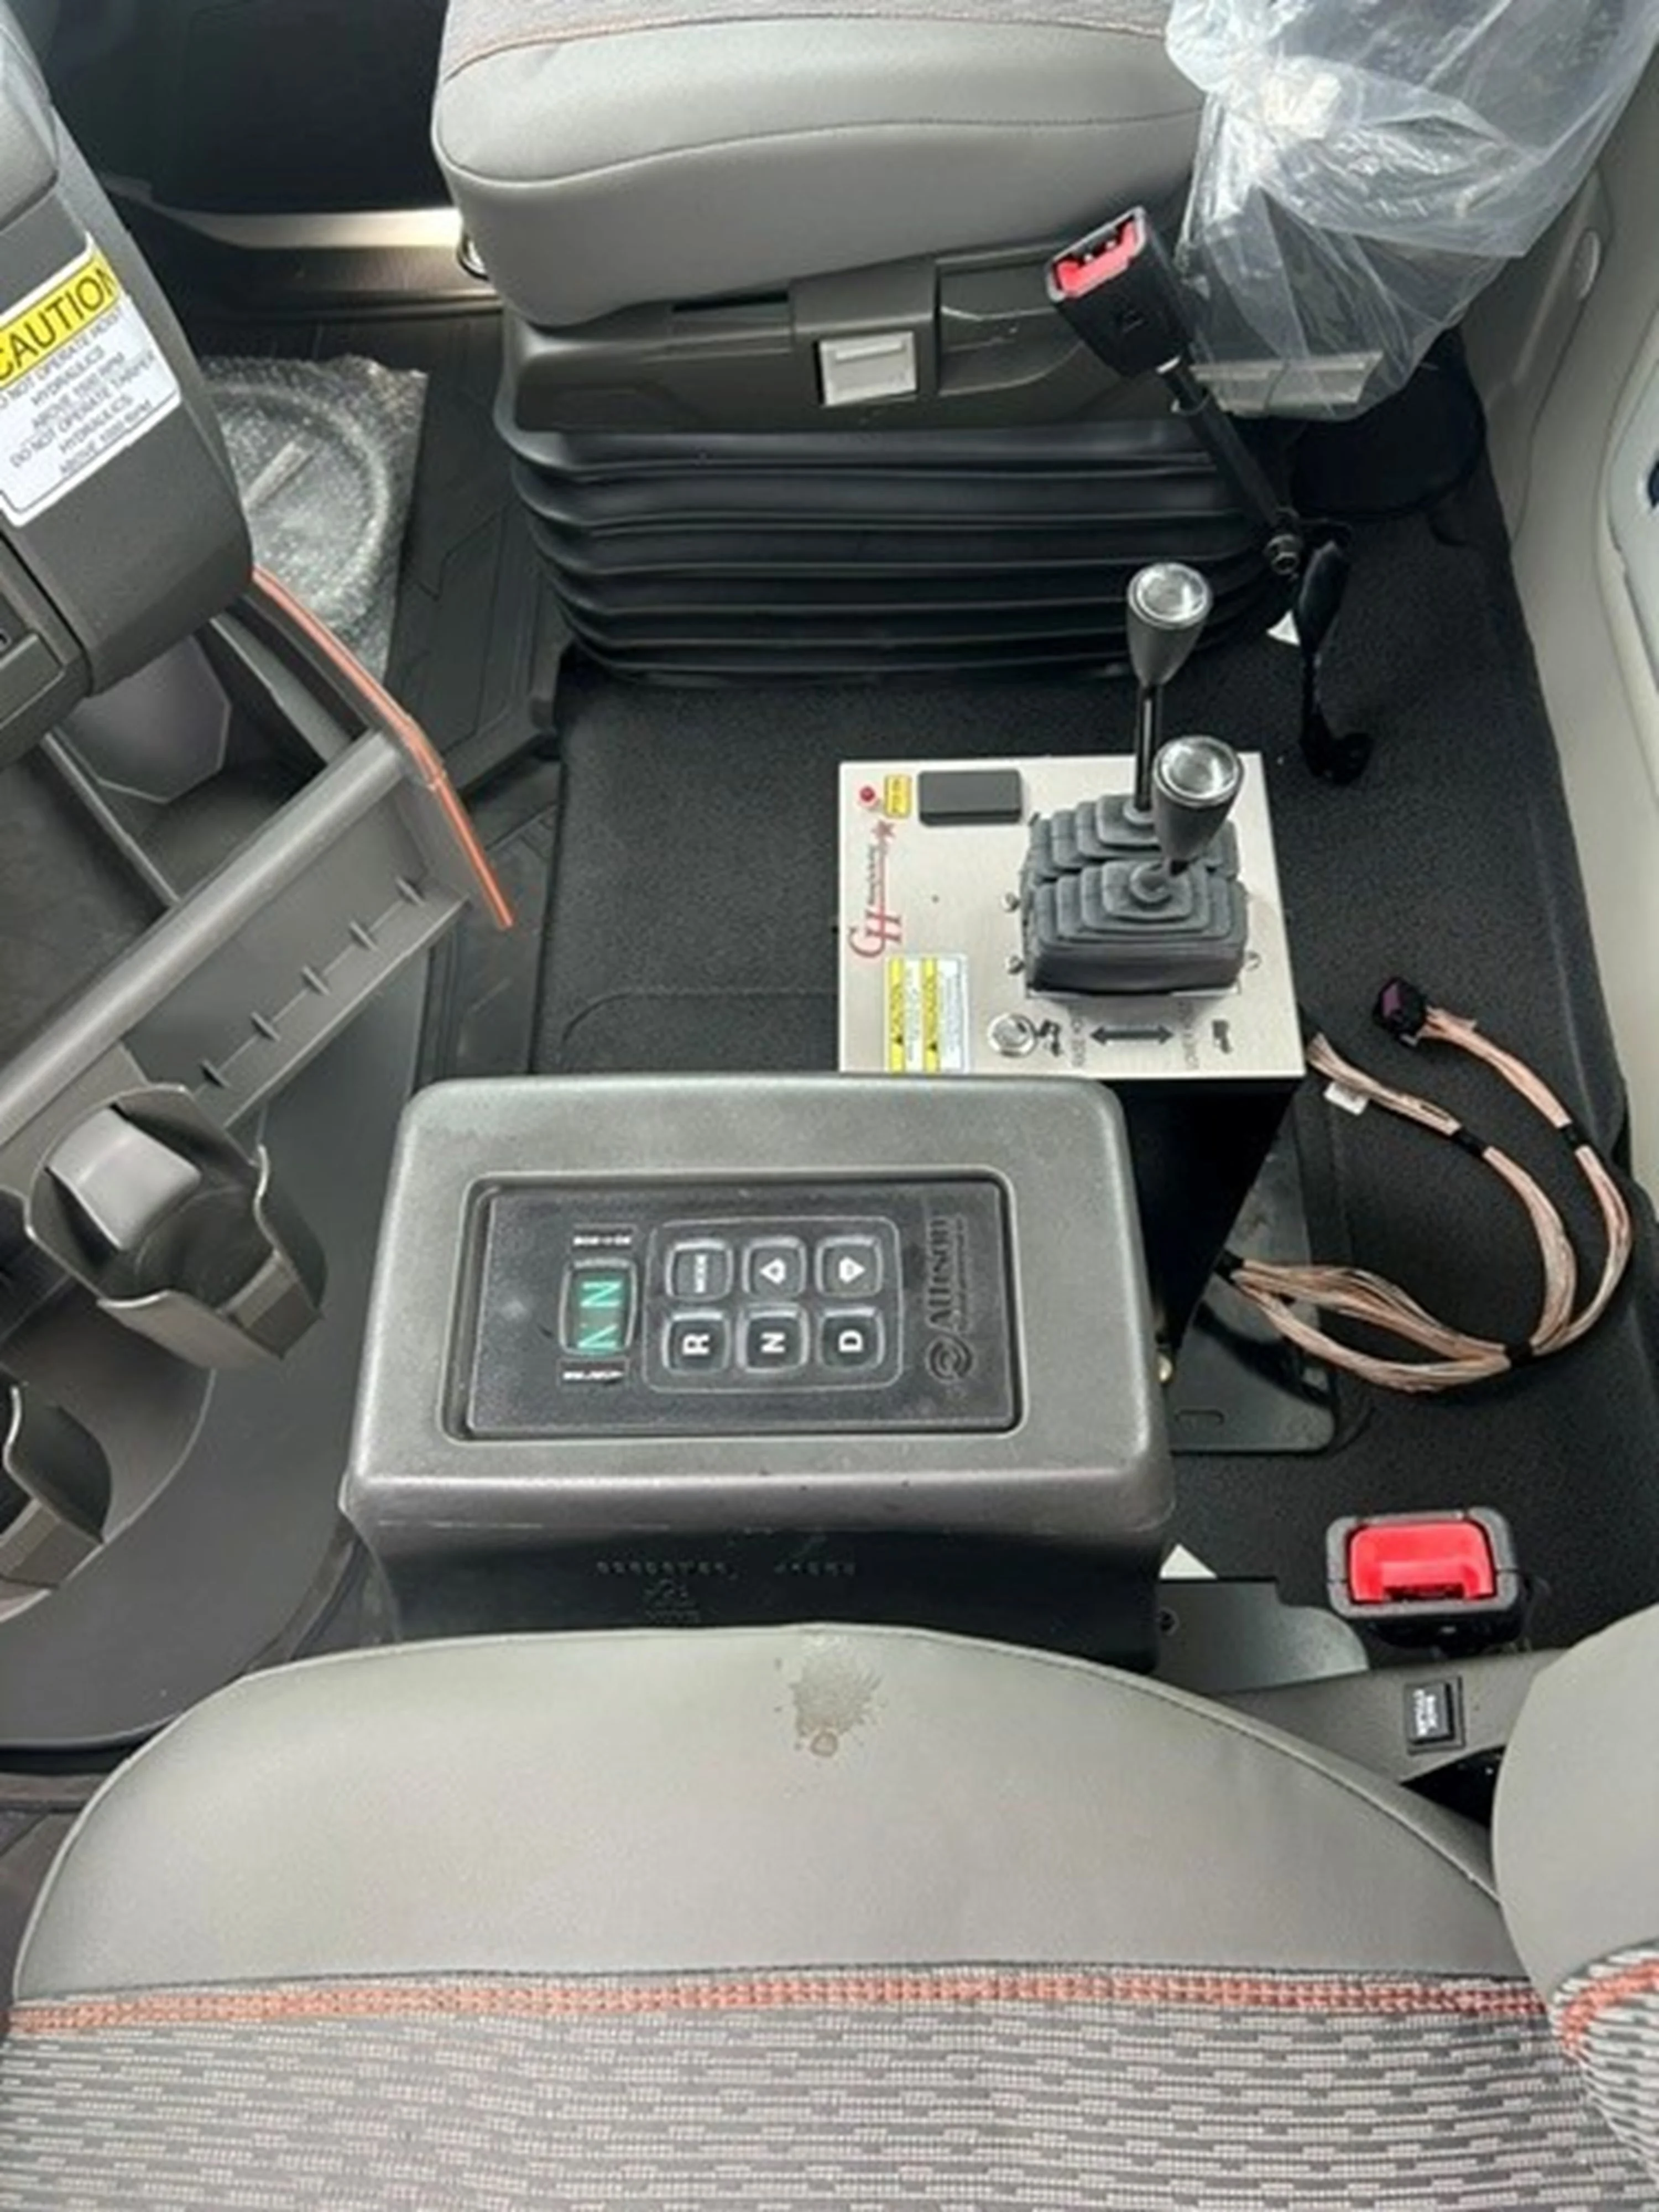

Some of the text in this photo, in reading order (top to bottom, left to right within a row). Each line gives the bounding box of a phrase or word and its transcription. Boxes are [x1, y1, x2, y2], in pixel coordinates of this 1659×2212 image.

[682, 1333, 711, 1355] R
[760, 1332, 786, 1354] N
[838, 1329, 864, 1353] D
